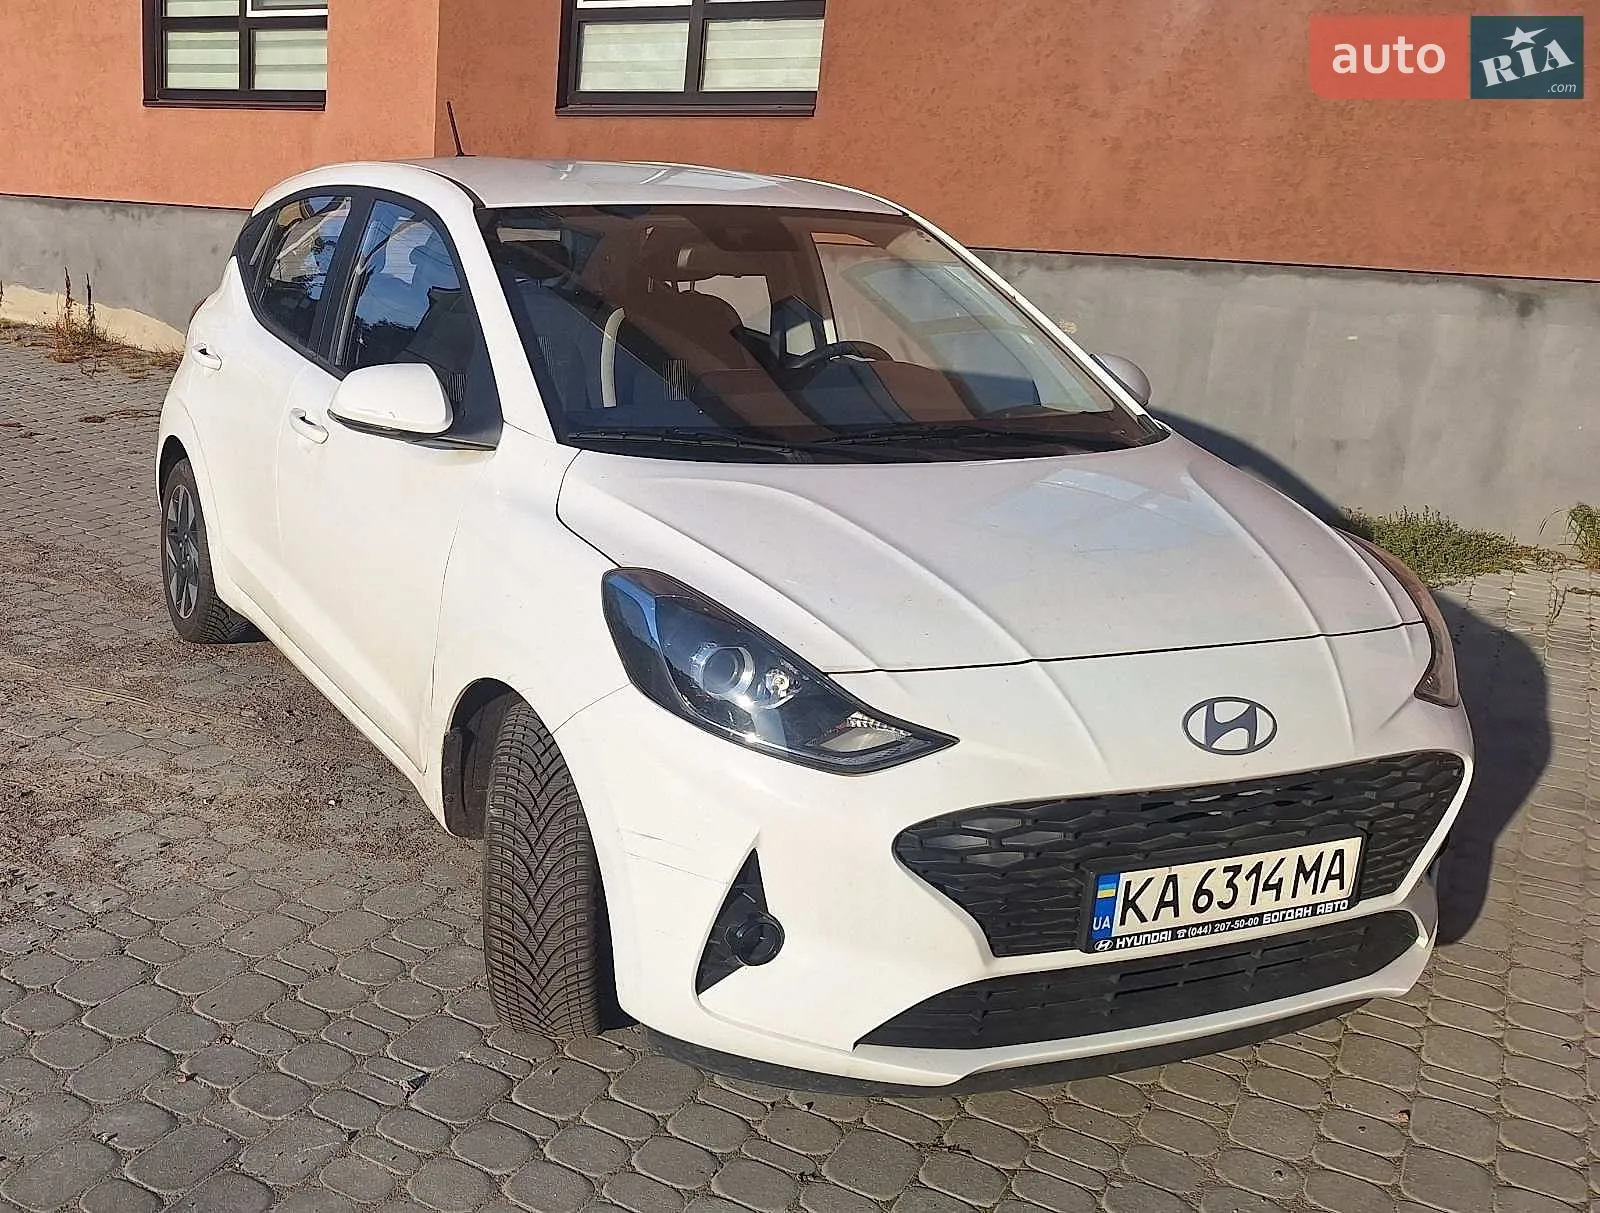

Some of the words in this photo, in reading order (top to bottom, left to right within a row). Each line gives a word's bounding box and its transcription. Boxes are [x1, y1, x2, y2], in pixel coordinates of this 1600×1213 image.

[1192, 856, 1286, 914] 6314
[1092, 915, 1111, 931] UA
[1115, 930, 1172, 949] HYUNDAI
[1187, 923, 1212, 938] (044)
[1213, 916, 1259, 933] 207-50-00
[1262, 905, 1313, 924] БОГДАН
[1316, 899, 1349, 914] АВТО
